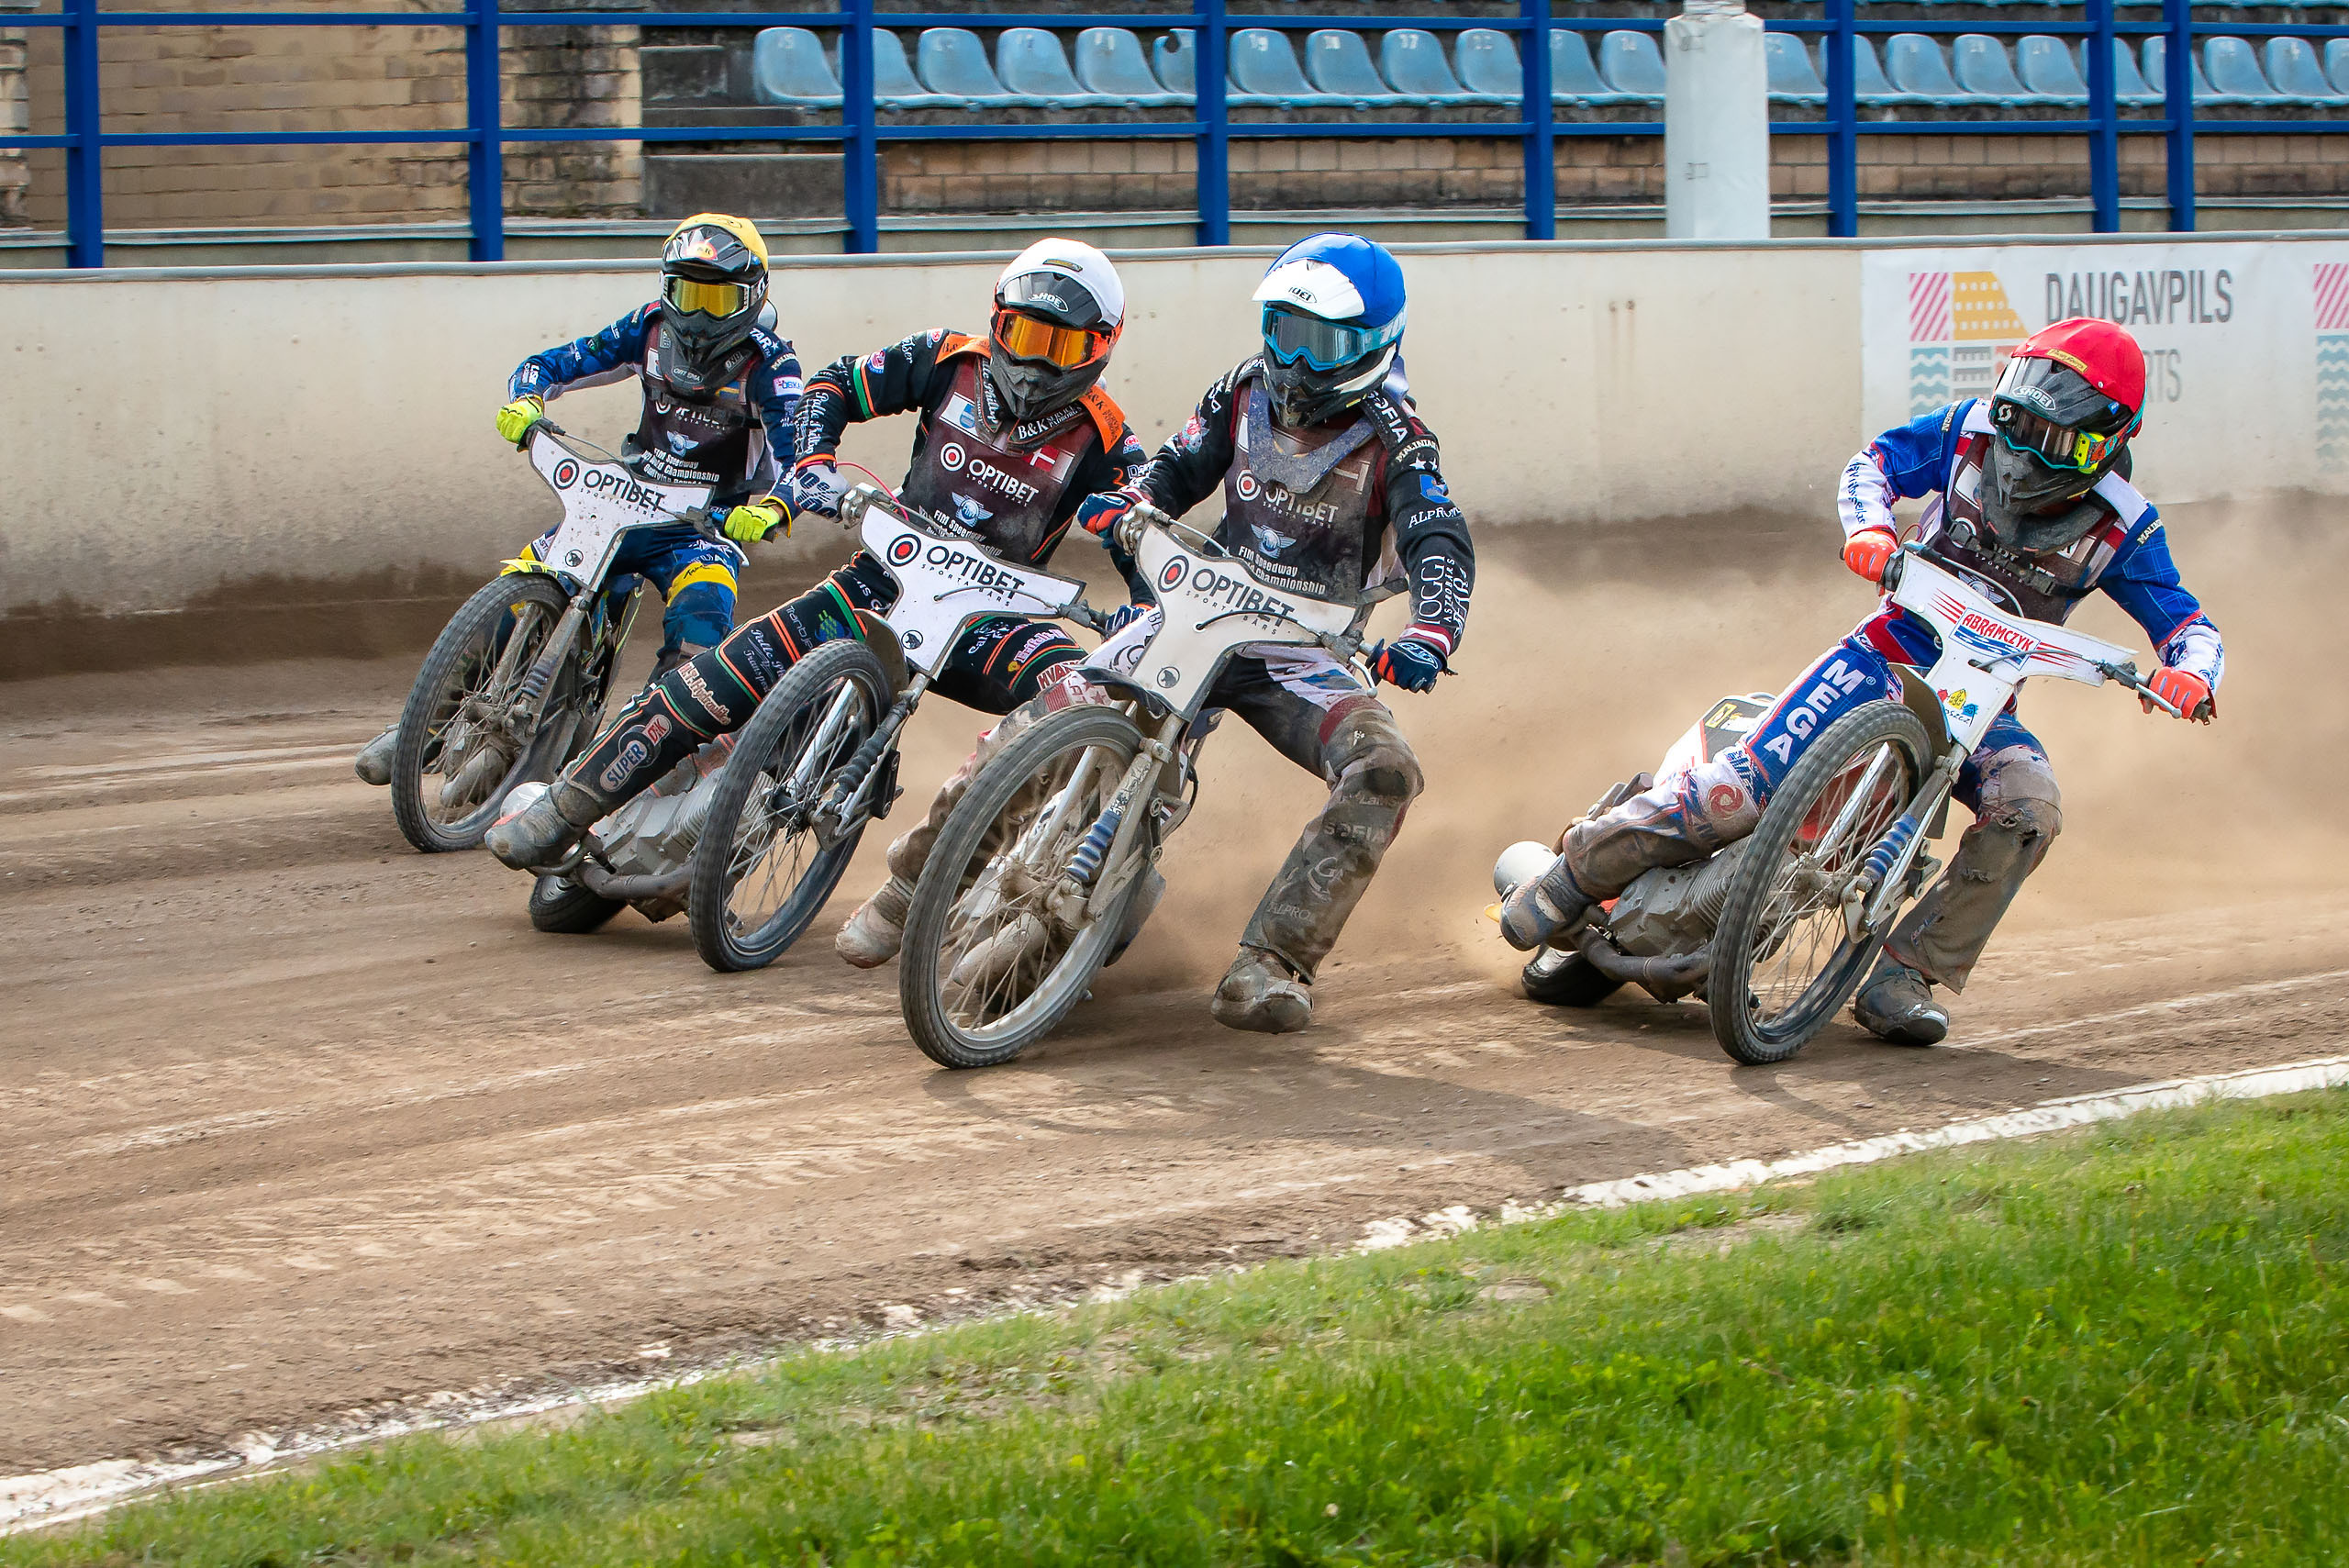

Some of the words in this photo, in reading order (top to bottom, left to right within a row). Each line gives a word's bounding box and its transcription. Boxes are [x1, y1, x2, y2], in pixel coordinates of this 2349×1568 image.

[2044, 270, 2233, 325] DAUGAVPILS
[2018, 387, 2053, 410] SHOEI
[1018, 418, 1050, 440] B&K
[584, 469, 666, 512] OPTIBET
[663, 464, 720, 483] Championship
[968, 459, 1040, 503] OPTIBET
[934, 510, 950, 525] FIM
[949, 520, 987, 542] Speedway
[1239, 545, 1254, 561] FIM
[920, 562, 970, 586] SPORTA
[926, 544, 1026, 600] OPTIBET
[1255, 568, 1327, 595] Championship
[1192, 567, 1296, 628] OPTIBET
[1961, 612, 2034, 652] ABRAMCZYK
[606, 742, 645, 787] SUPER
